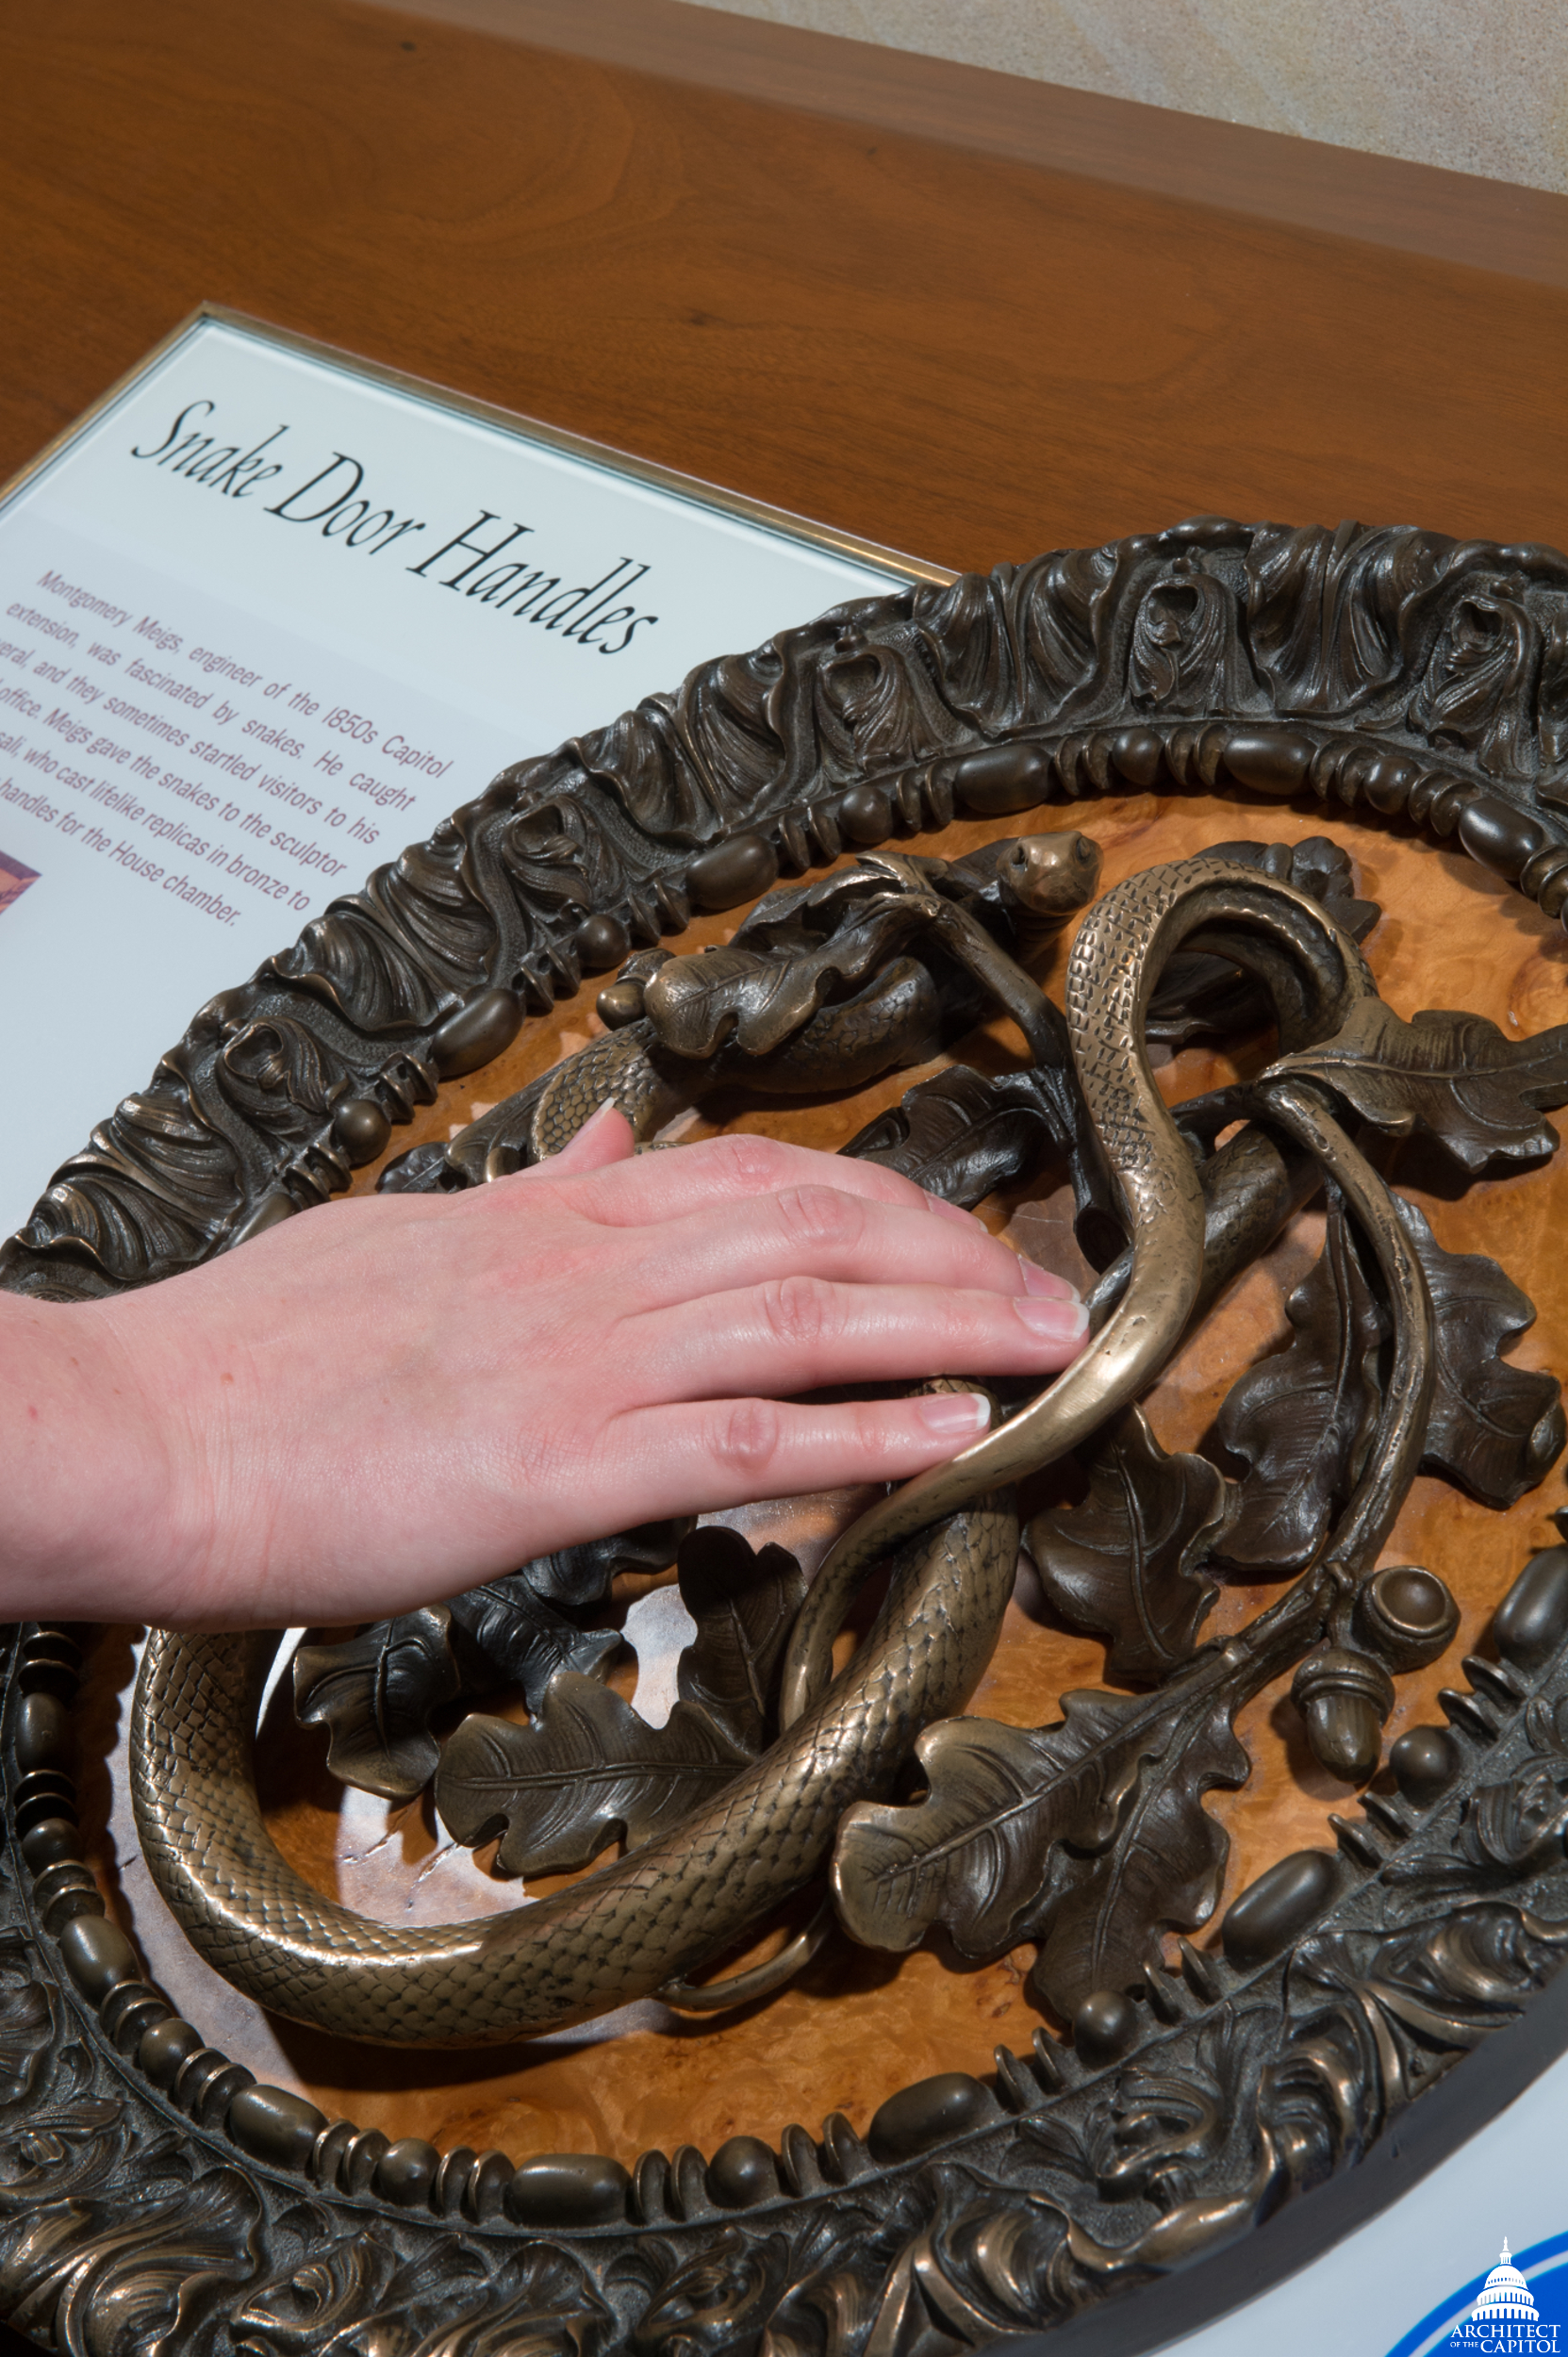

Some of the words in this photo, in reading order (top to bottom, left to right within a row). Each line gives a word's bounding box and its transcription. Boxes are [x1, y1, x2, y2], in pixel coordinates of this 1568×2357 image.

[131, 400, 289, 499] Snake
[263, 452, 426, 555] Door
[405, 509, 659, 654] Handles
[6, 602, 79, 650] extension,
[87, 642, 122, 666] was
[124, 657, 215, 709] fascinated
[212, 701, 239, 725] by
[241, 719, 305, 759] snakes.
[313, 750, 343, 776] He
[349, 772, 416, 812] caught
[33, 661, 72, 684] and
[66, 676, 106, 705] they
[103, 697, 190, 747] sometimes
[189, 741, 262, 781] startled
[257, 774, 322, 815] visitors
[323, 807, 347, 827] to
[347, 816, 380, 844] his
[36, 569, 134, 628] Montgomery
[131, 616, 184, 655] Meigs,
[189, 647, 263, 687] engineer
[263, 683, 292, 700] of
[288, 692, 320, 716] the
[322, 707, 378, 744] 1850s
[382, 735, 454, 778] Capitol
[0, 777, 58, 822] handles
[56, 812, 86, 835] for
[81, 827, 111, 851] the
[108, 840, 165, 882] House
[162, 875, 241, 927] chamber.
[24, 748, 58, 773] who
[56, 766, 96, 793] cast
[89, 780, 145, 820] lifelike
[141, 813, 210, 856] replicas
[206, 844, 229, 867] in
[225, 853, 289, 899] bronze
[287, 890, 310, 911] to
[42, 708, 93, 744] Meigs
[86, 736, 131, 764] gave
[129, 755, 160, 780] the
[157, 772, 220, 811] snakes
[218, 802, 240, 821] to
[239, 813, 272, 838] the
[270, 832, 348, 877] sculptor
